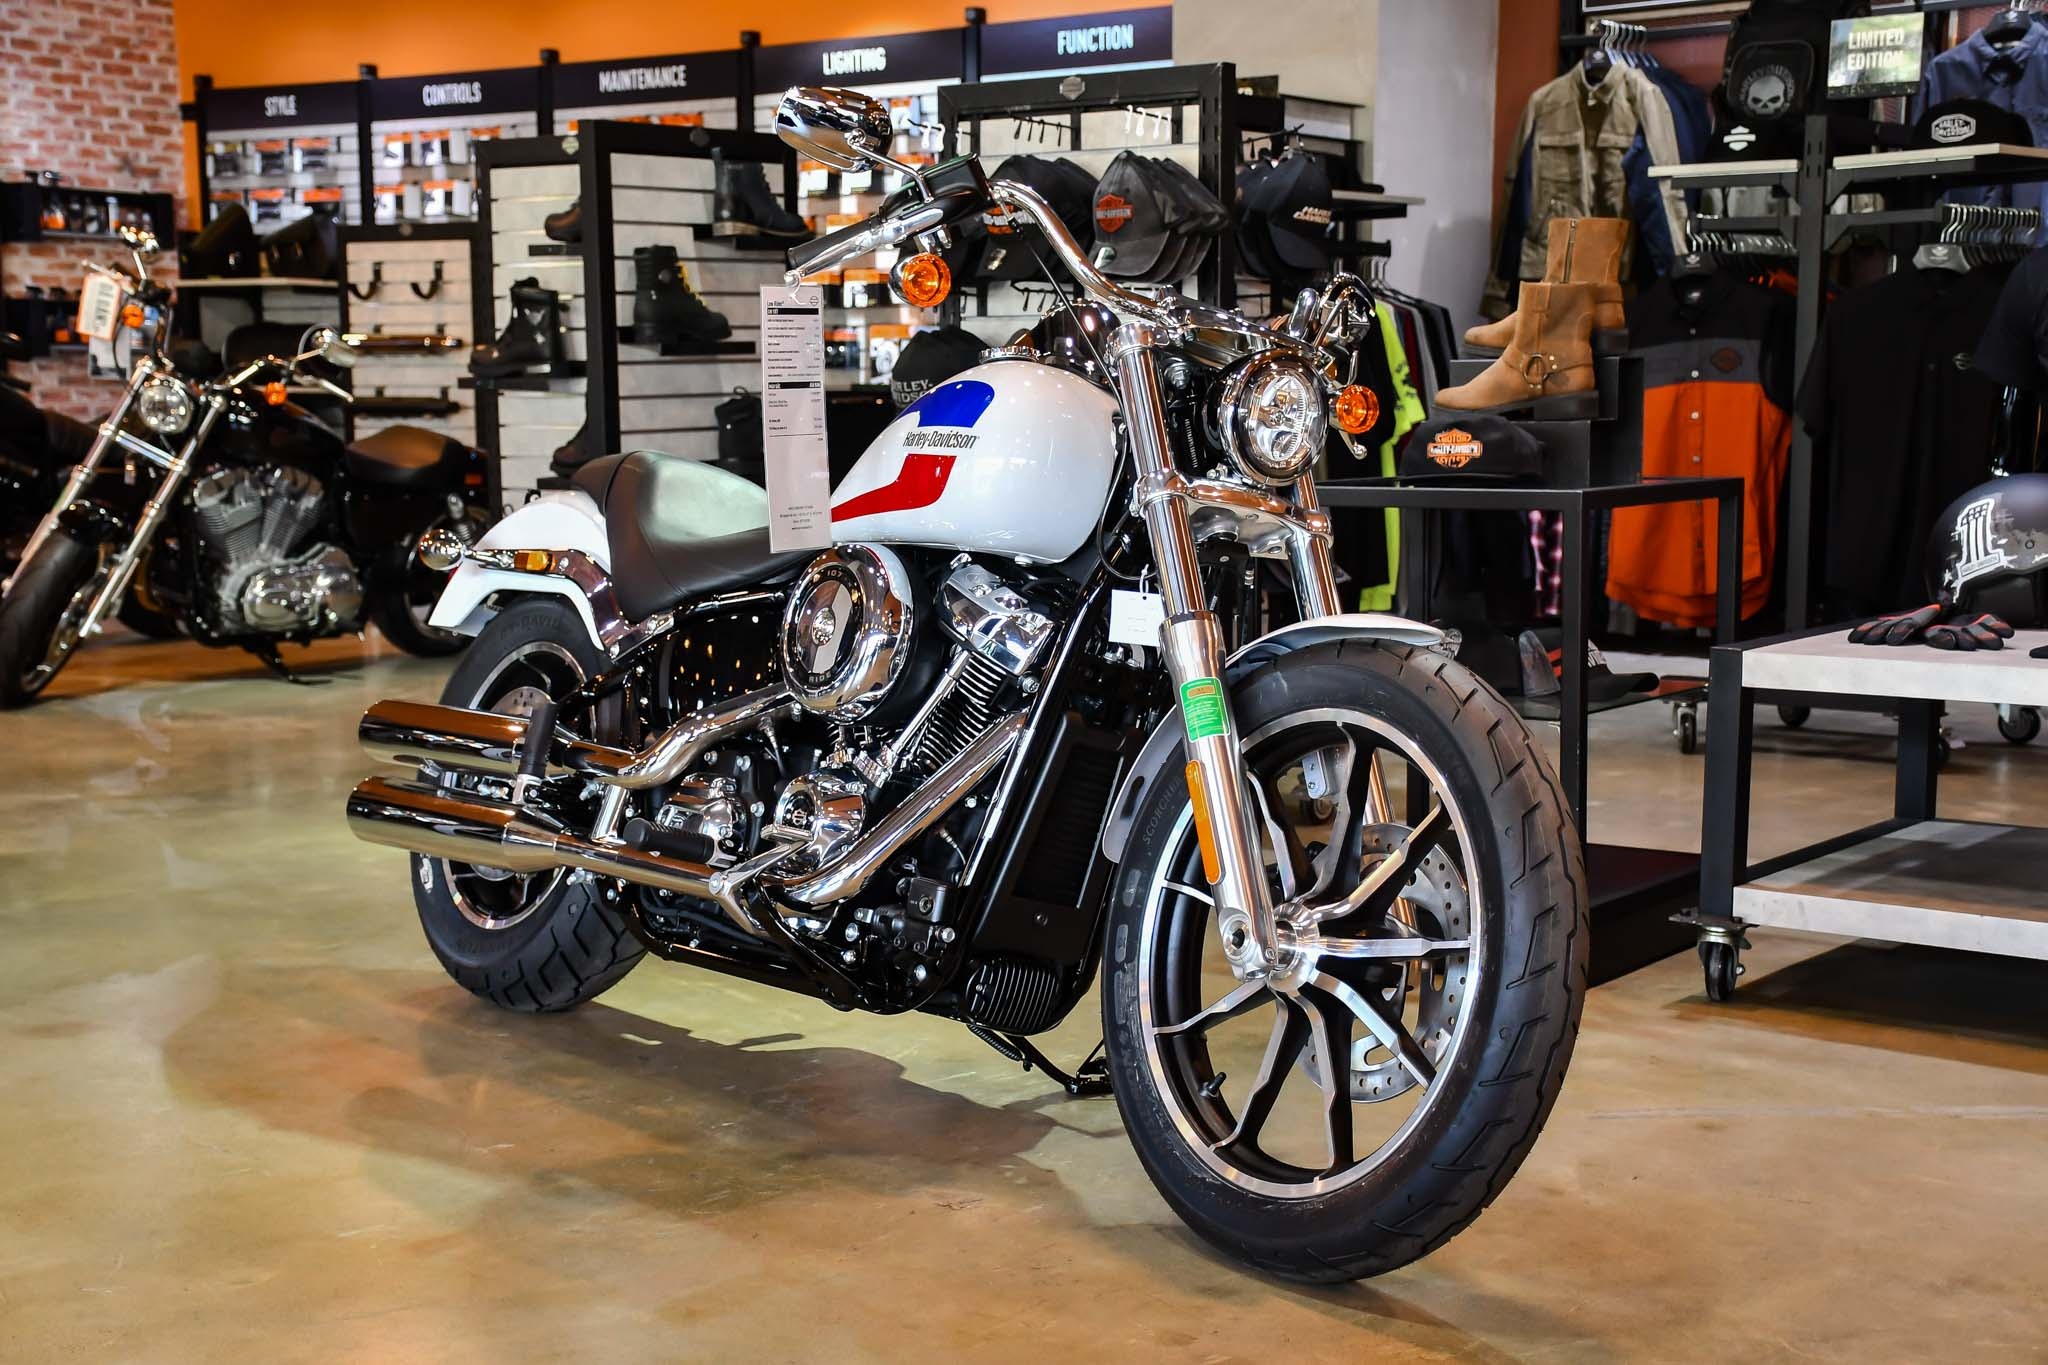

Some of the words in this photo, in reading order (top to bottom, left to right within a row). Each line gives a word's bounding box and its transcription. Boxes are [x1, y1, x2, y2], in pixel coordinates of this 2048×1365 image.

[1057, 23, 1134, 56] FUNCTION
[1848, 27, 1905, 50] LIMITED
[822, 46, 887, 75] LIGHTING
[1847, 50, 1905, 71] EDITION
[598, 64, 687, 93] MAINTENANCE
[264, 94, 298, 118] STYLE
[422, 81, 482, 107] CONTROLS
[903, 430, 977, 449] Harley-Davidson
